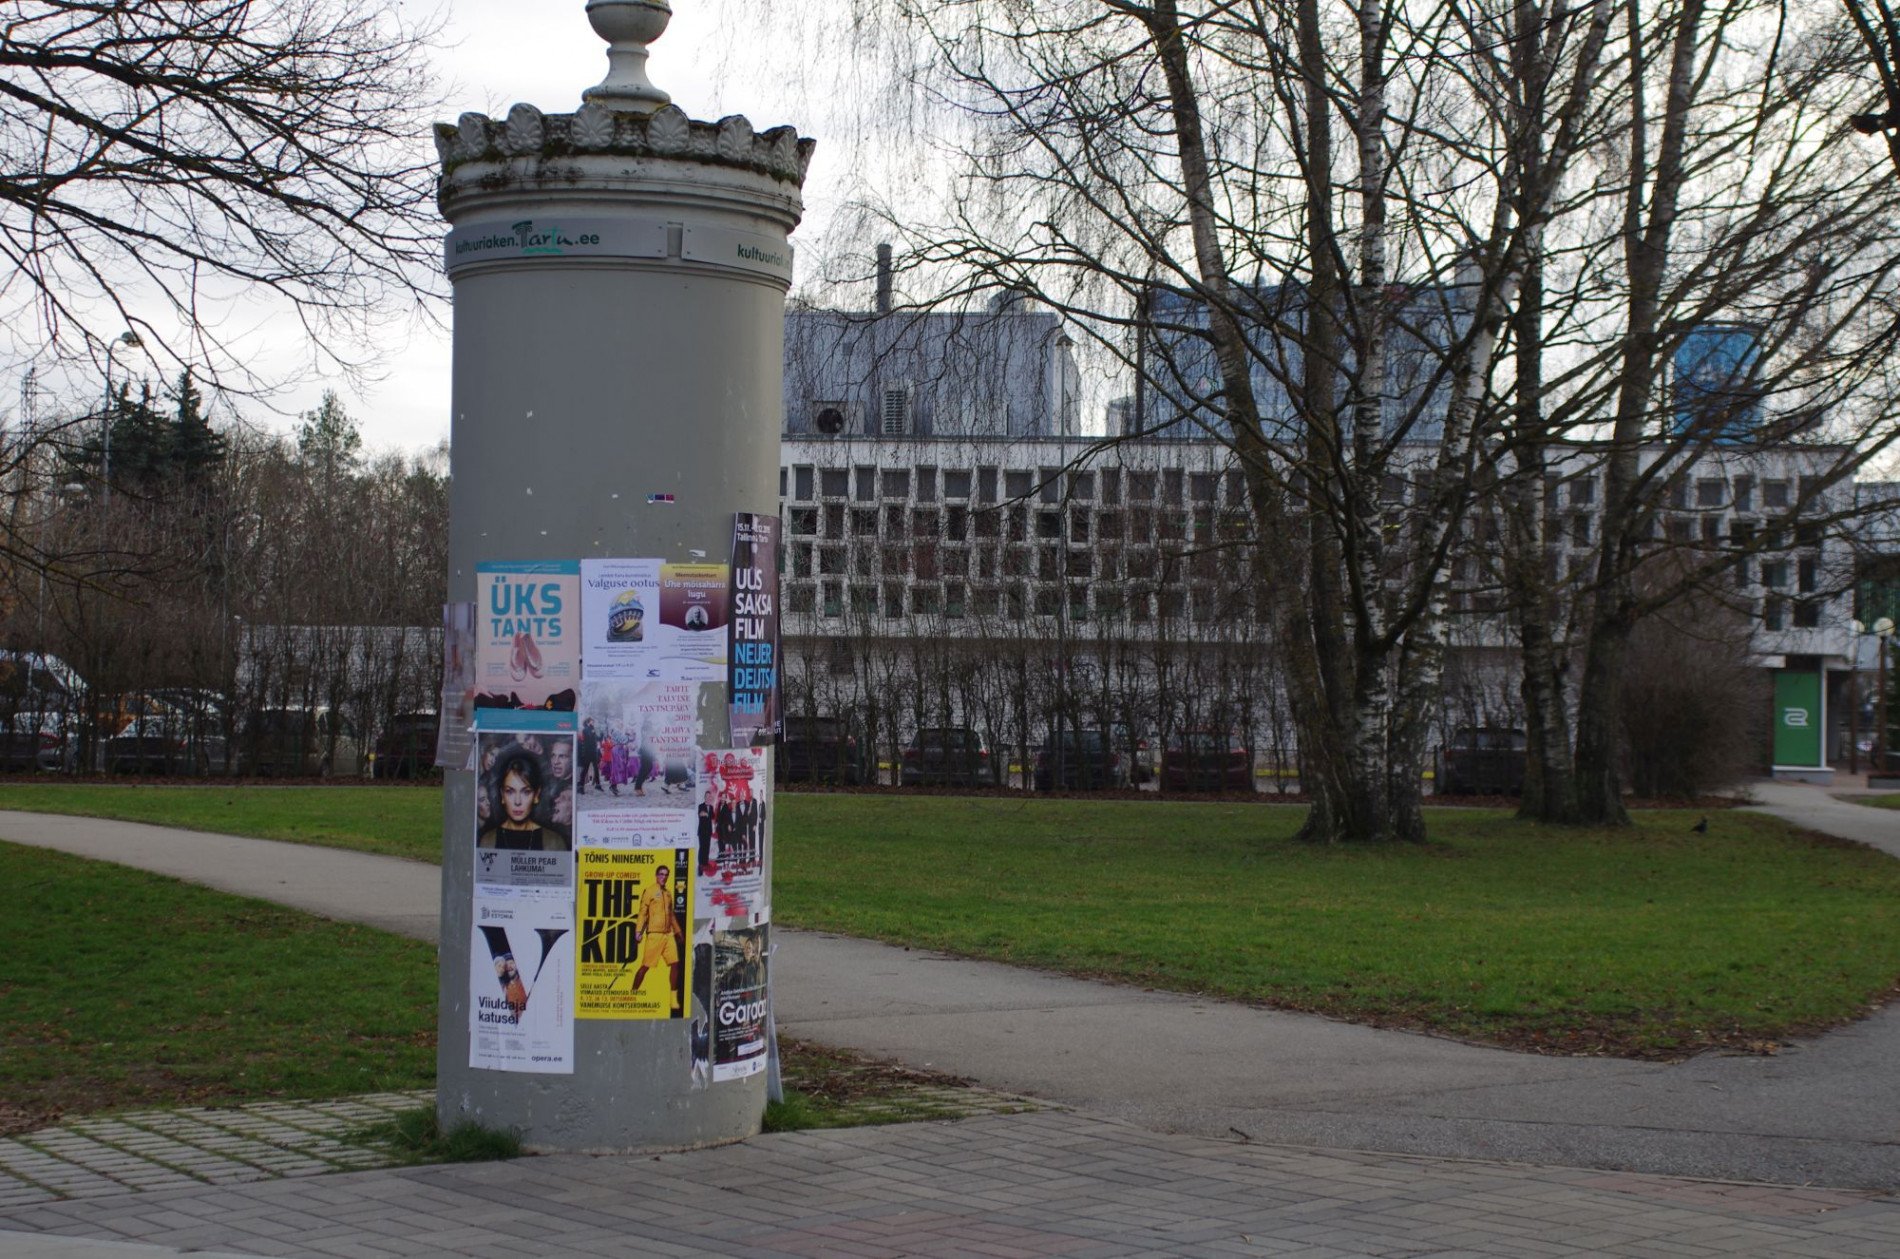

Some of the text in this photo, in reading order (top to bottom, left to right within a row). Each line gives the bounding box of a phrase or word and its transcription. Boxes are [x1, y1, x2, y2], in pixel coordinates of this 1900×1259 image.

[587, 578, 660, 590] Valguse ootus
[664, 579, 681, 588] Ühe
[736, 567, 763, 590] UUS
[490, 575, 563, 616] ÜKS
[735, 592, 772, 616] SAKSA
[490, 617, 562, 638] TANTS
[735, 617, 765, 640] FILM
[734, 643, 772, 665] NEUER
[734, 692, 765, 715] FILM
[584, 852, 655, 864] TÕNIS NIINEMETS
[584, 879, 641, 919] THE
[581, 919, 639, 964] KID
[478, 996, 527, 1012] Viiuldaja
[478, 1010, 519, 1025] katusel
[531, 1055, 563, 1063] opera.ee
